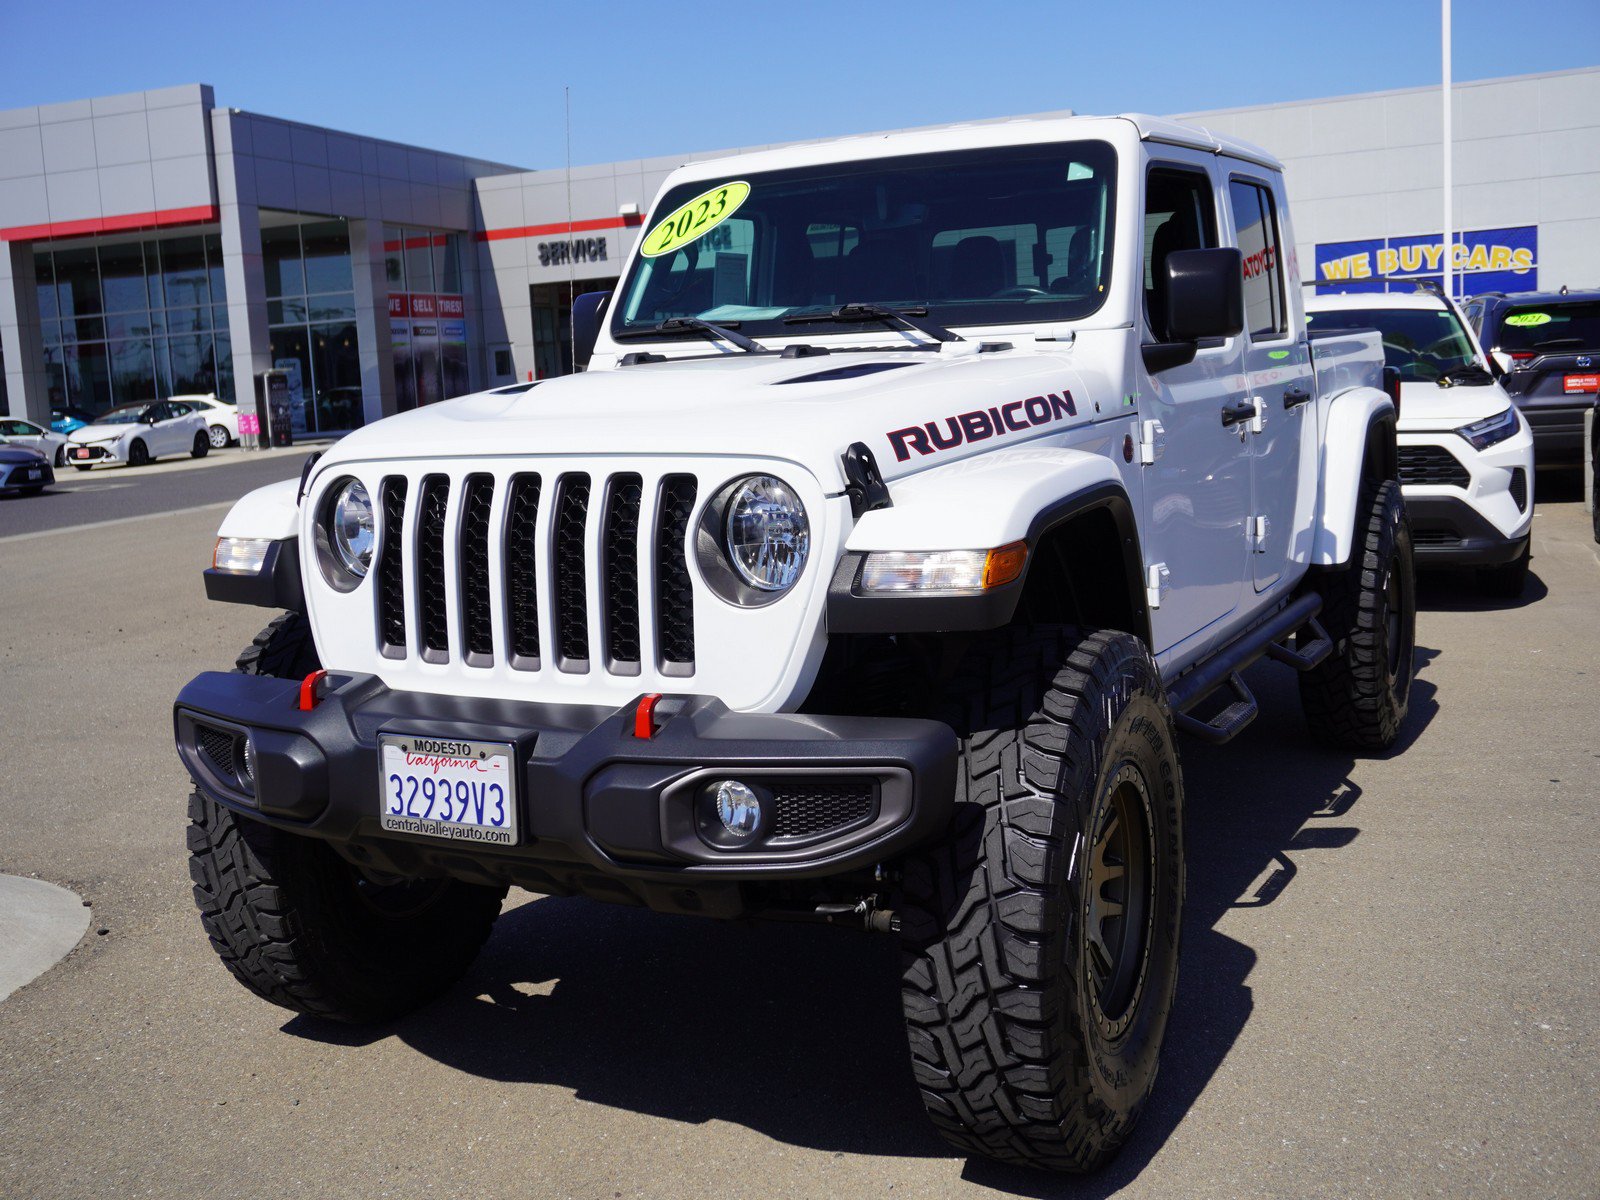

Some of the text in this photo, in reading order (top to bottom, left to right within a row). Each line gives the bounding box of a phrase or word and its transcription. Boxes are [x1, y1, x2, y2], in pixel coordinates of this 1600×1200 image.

[657, 188, 730, 251] 2023
[537, 236, 608, 267] SERVICE
[1321, 244, 1534, 280] WE BUY CARS
[389, 299, 463, 313] WE SELL TIRES!
[1513, 314, 1542, 324] 2021
[886, 390, 1078, 462] RUBICON
[414, 739, 471, 756] MODESTO
[406, 752, 487, 774] California
[389, 773, 505, 827] 32939V3
[386, 818, 510, 843] centralvalleyauto.com
